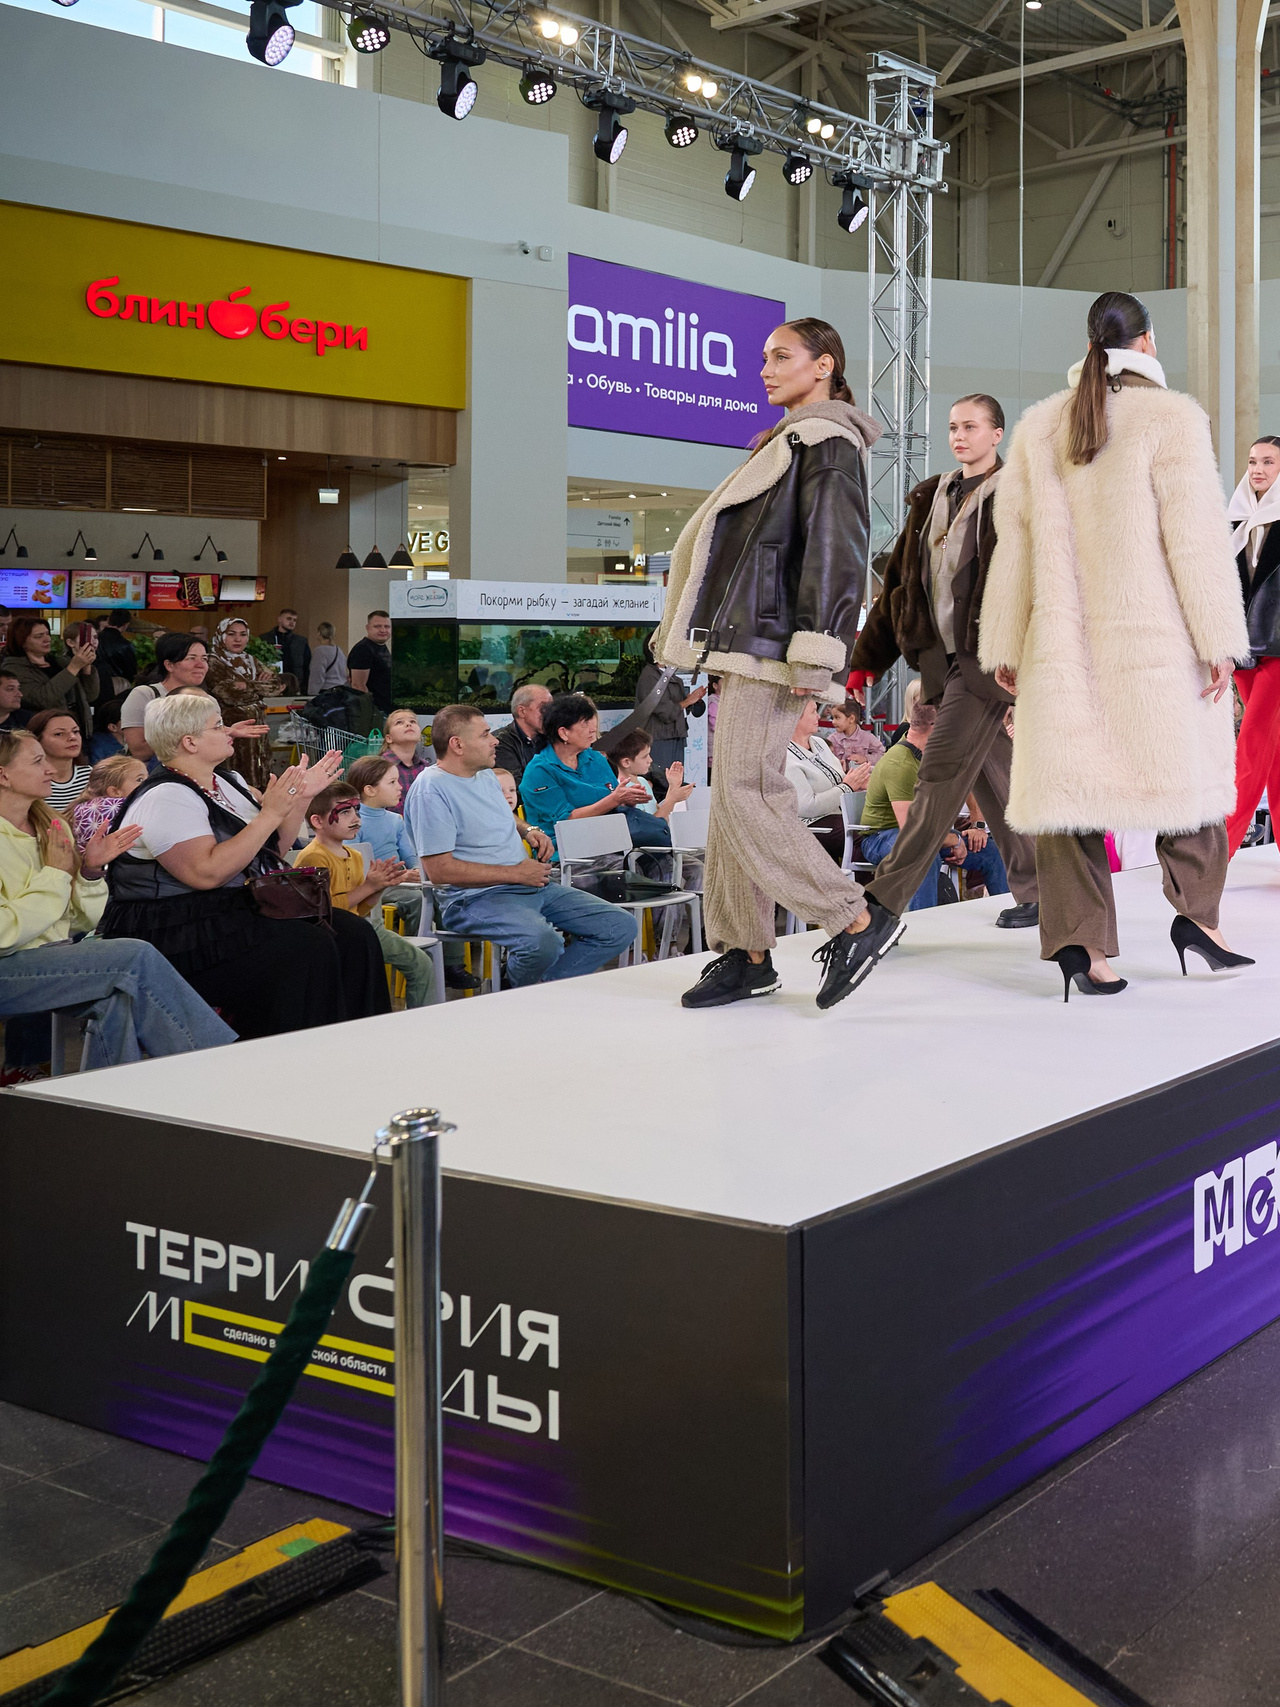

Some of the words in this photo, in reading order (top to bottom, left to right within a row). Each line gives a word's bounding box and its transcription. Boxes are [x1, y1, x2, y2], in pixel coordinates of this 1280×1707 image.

[567, 304, 737, 378] amilia
[586, 373, 632, 395] Обувь
[644, 382, 695, 405] Товары
[698, 394, 722, 408] для
[724, 399, 758, 413] дома
[407, 531, 433, 553] VE
[480, 593, 523, 609] Покорми
[526, 593, 557, 610] рыбку
[573, 596, 609, 608] загадай
[612, 598, 649, 610] желание
[223, 1327, 267, 1346] сделано
[269, 1339, 277, 1348] в
[339, 1355, 387, 1377] области
